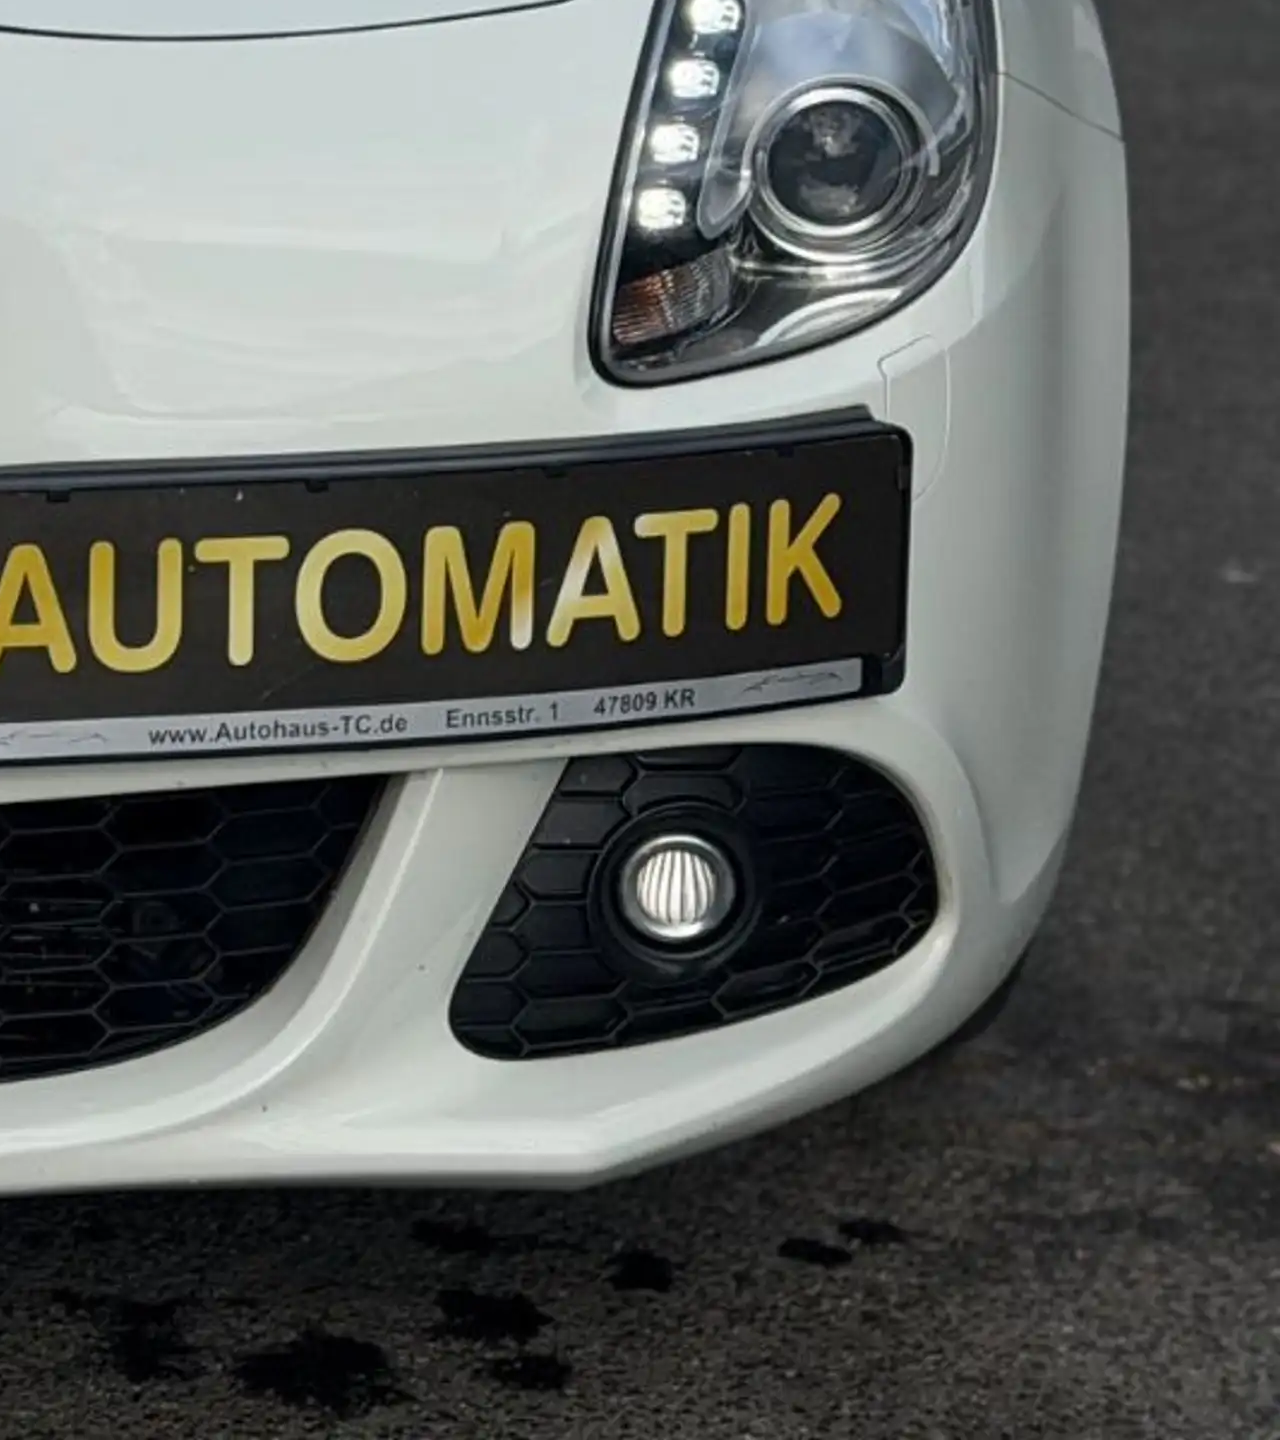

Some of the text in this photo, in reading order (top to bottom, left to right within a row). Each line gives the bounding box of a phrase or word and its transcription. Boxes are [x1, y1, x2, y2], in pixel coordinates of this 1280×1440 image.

[148, 688, 696, 744] www.Autohaus-TC.de Ennsstr. 1 47809 KR
